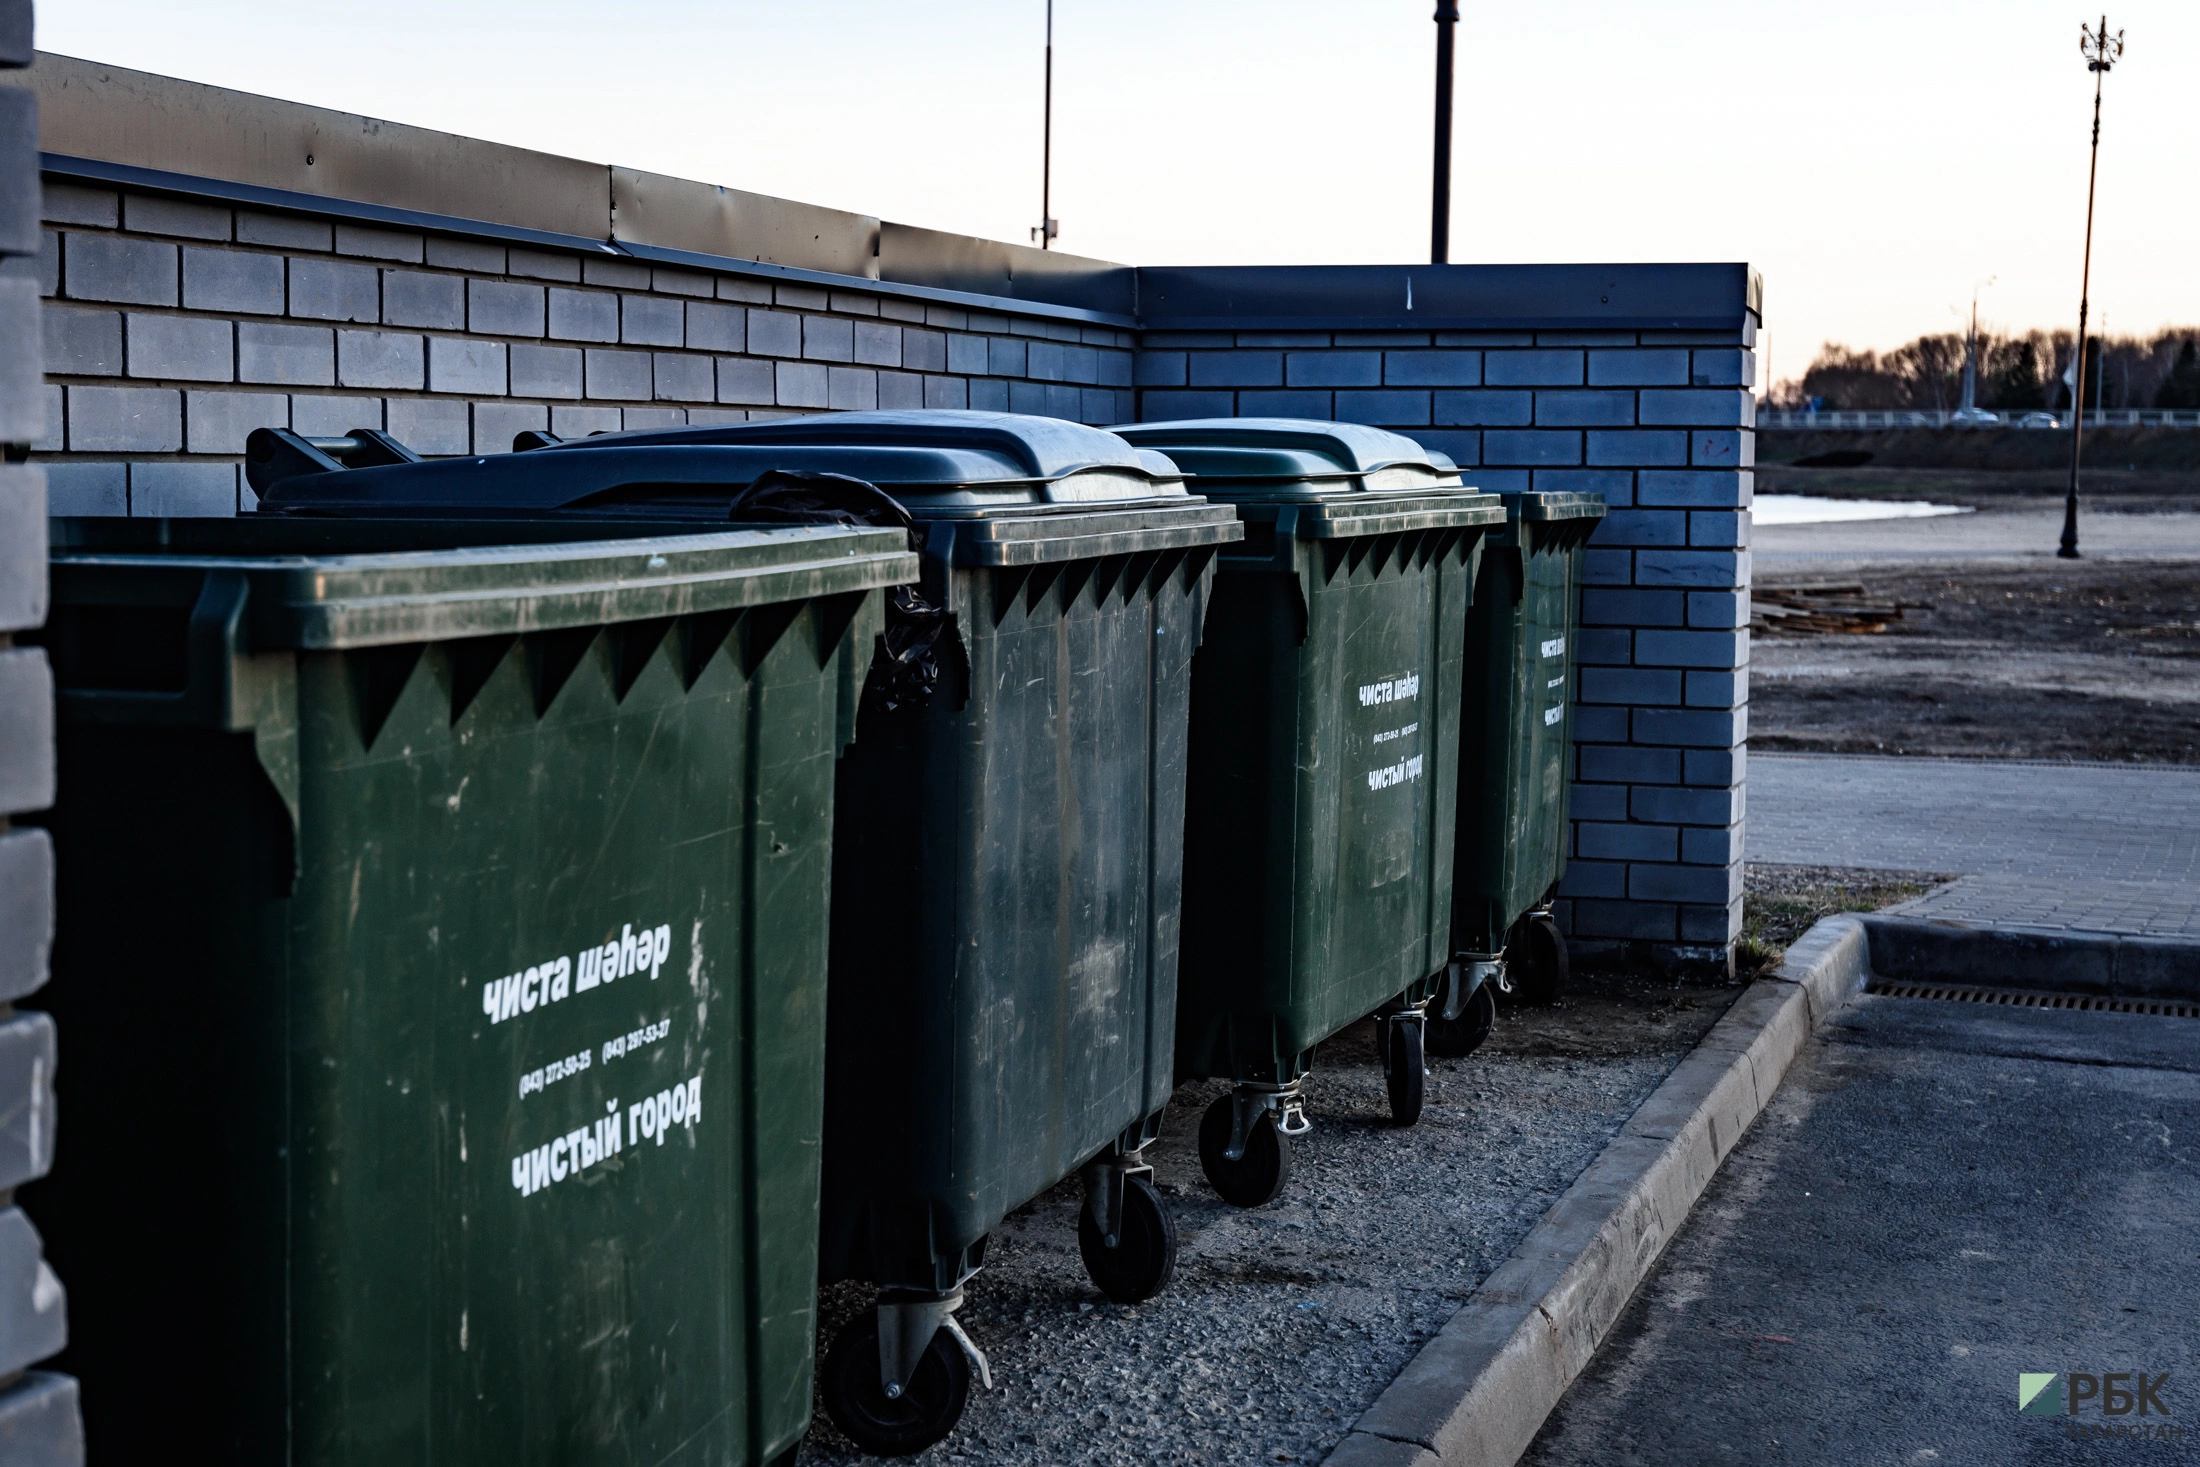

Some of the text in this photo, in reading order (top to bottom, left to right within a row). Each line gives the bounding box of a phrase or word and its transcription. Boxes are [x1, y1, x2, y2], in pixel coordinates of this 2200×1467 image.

[1359, 681, 1392, 706] чиста
[1368, 754, 1423, 791] чистый город
[483, 923, 671, 1024] чиста шәһәр
[519, 1069, 544, 1100] (843)
[545, 1049, 591, 1085] 272-50-25
[602, 1036, 626, 1066] (843)
[512, 1075, 702, 1197] чистый город
